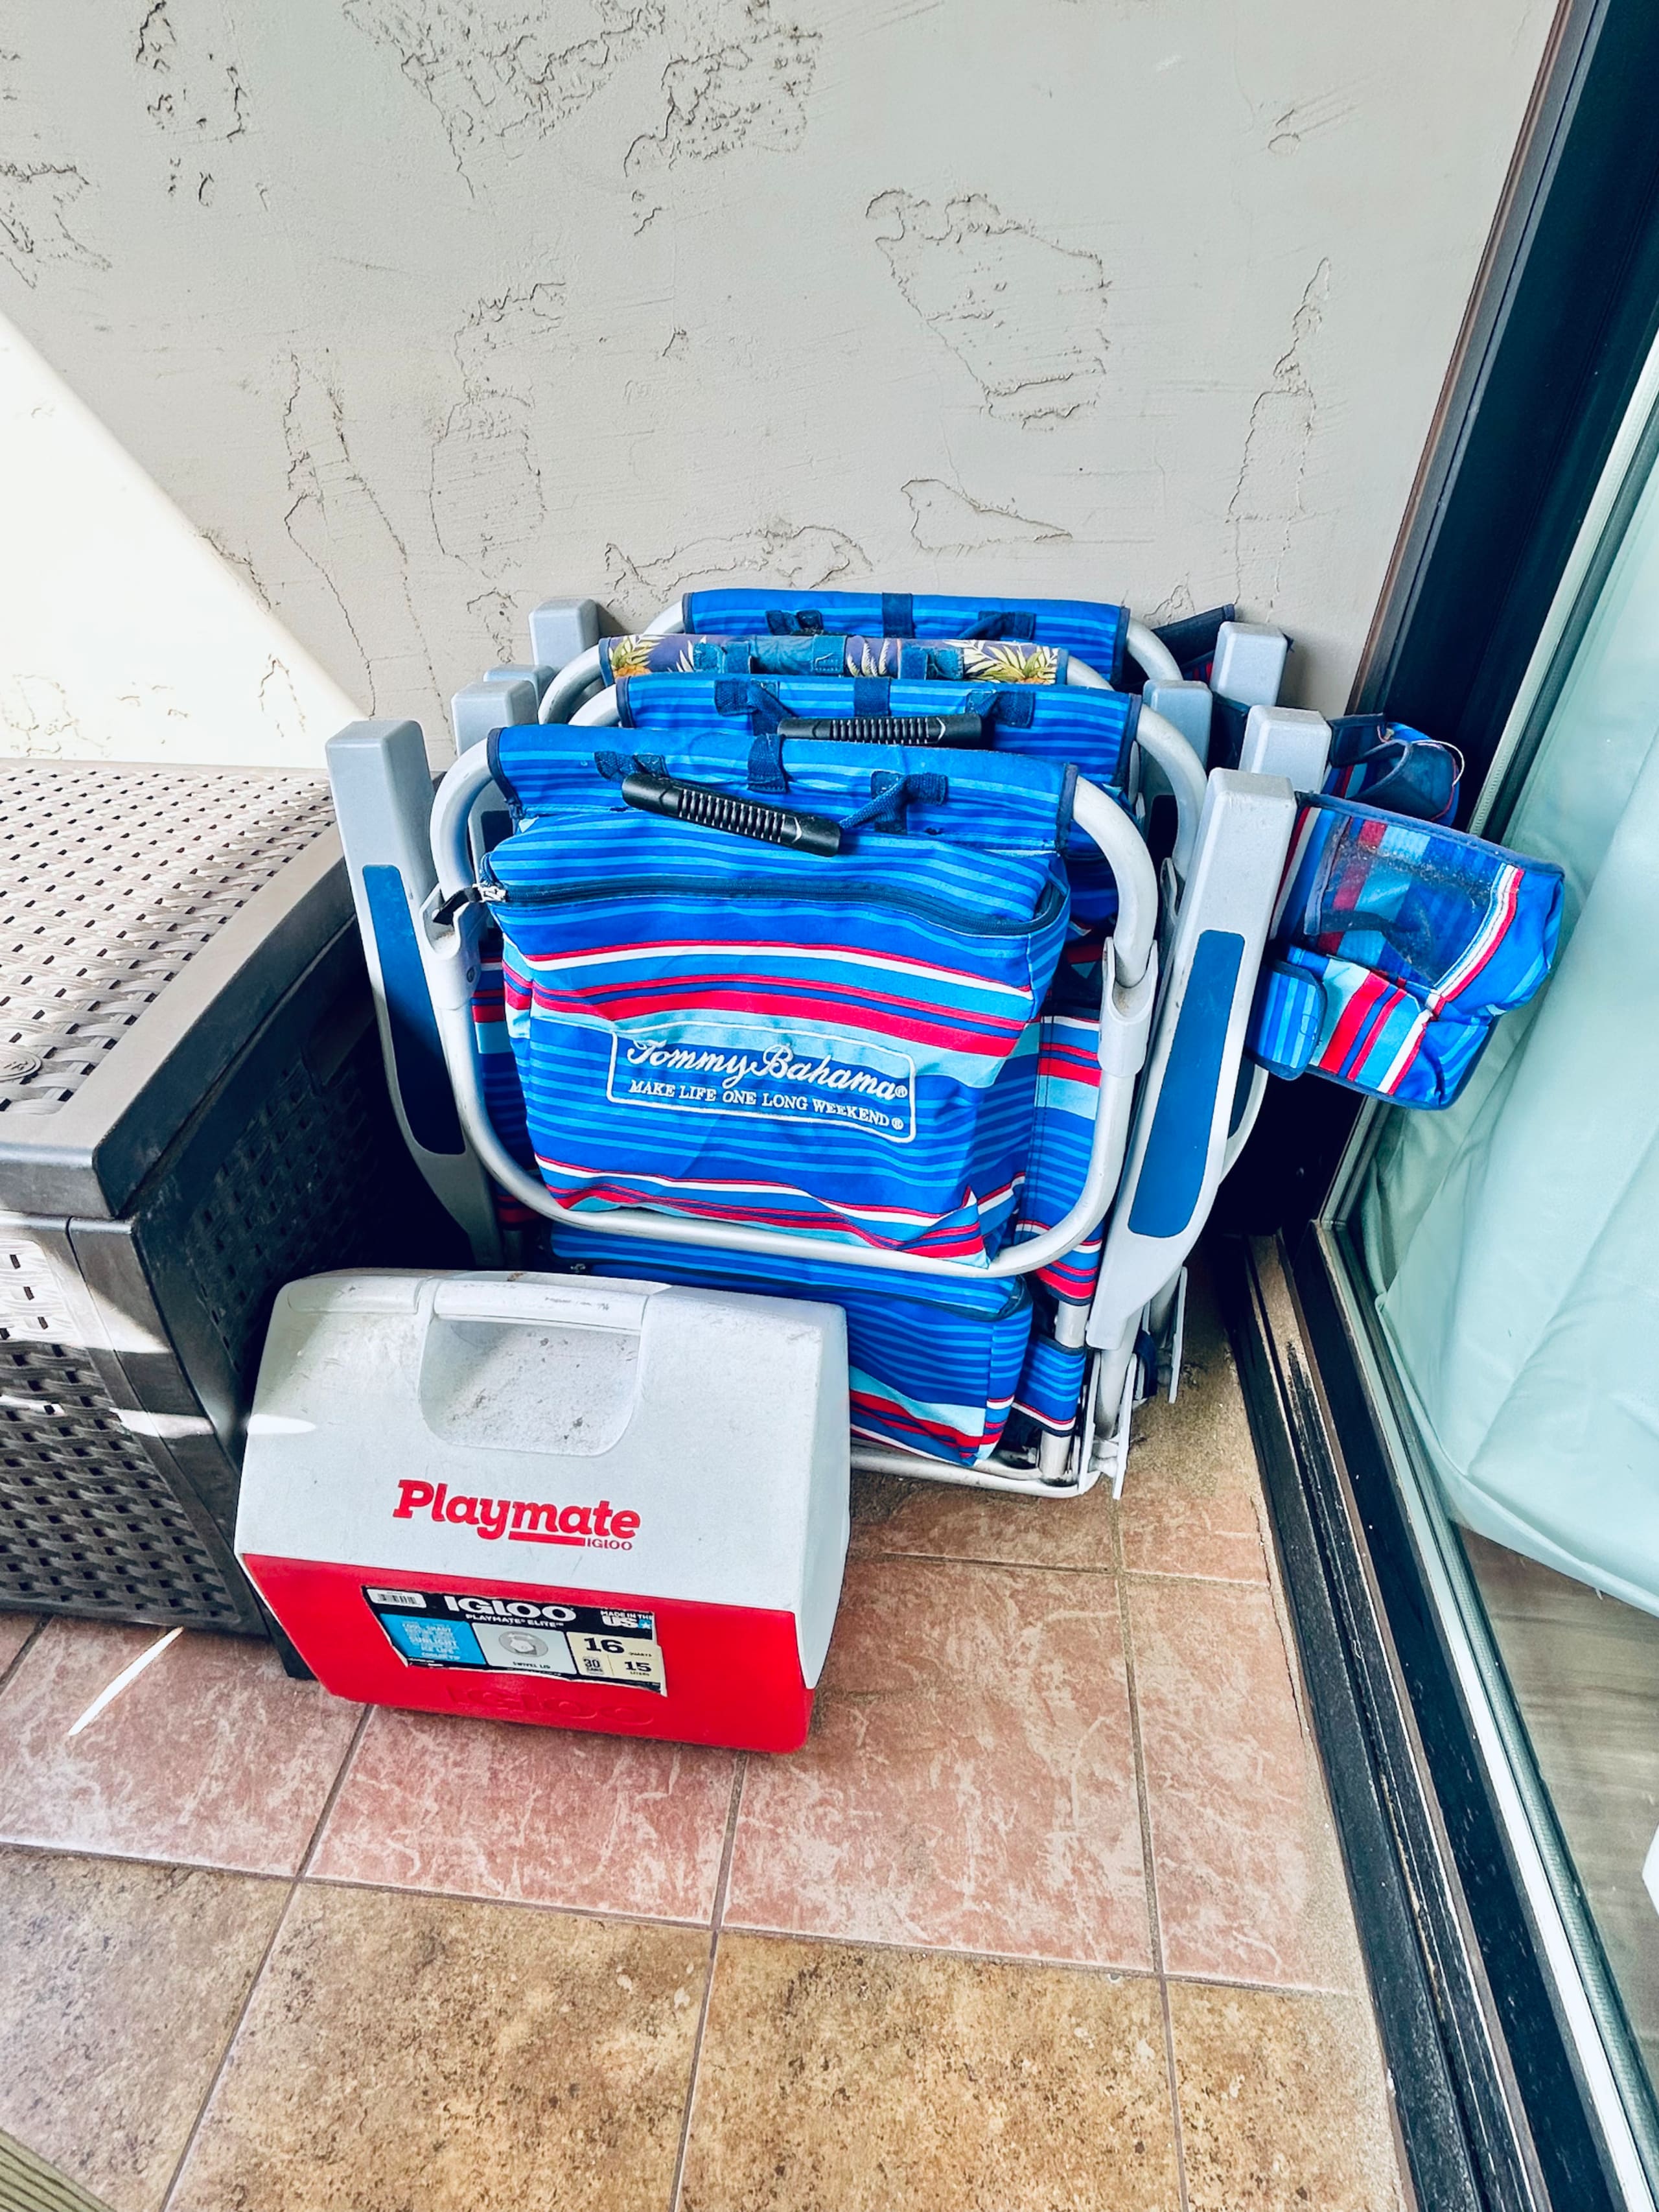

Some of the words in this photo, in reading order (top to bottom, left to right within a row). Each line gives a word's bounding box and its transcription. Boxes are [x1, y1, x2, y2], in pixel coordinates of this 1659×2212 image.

[627, 1040, 748, 1089] Tommy
[629, 1080, 676, 1097] MAKE
[679, 1086, 717, 1101] LIFE
[722, 1089, 756, 1105] ONE
[761, 1093, 808, 1110] LONG
[393, 1479, 642, 1540] Playmate
[586, 1537, 633, 1551] IGLOO
[443, 1595, 577, 1622] IGLOO
[600, 1610, 626, 1618] MADE
[584, 1637, 625, 1653] 16
[583, 1659, 601, 1668] 30
[624, 1661, 652, 1671] 15
